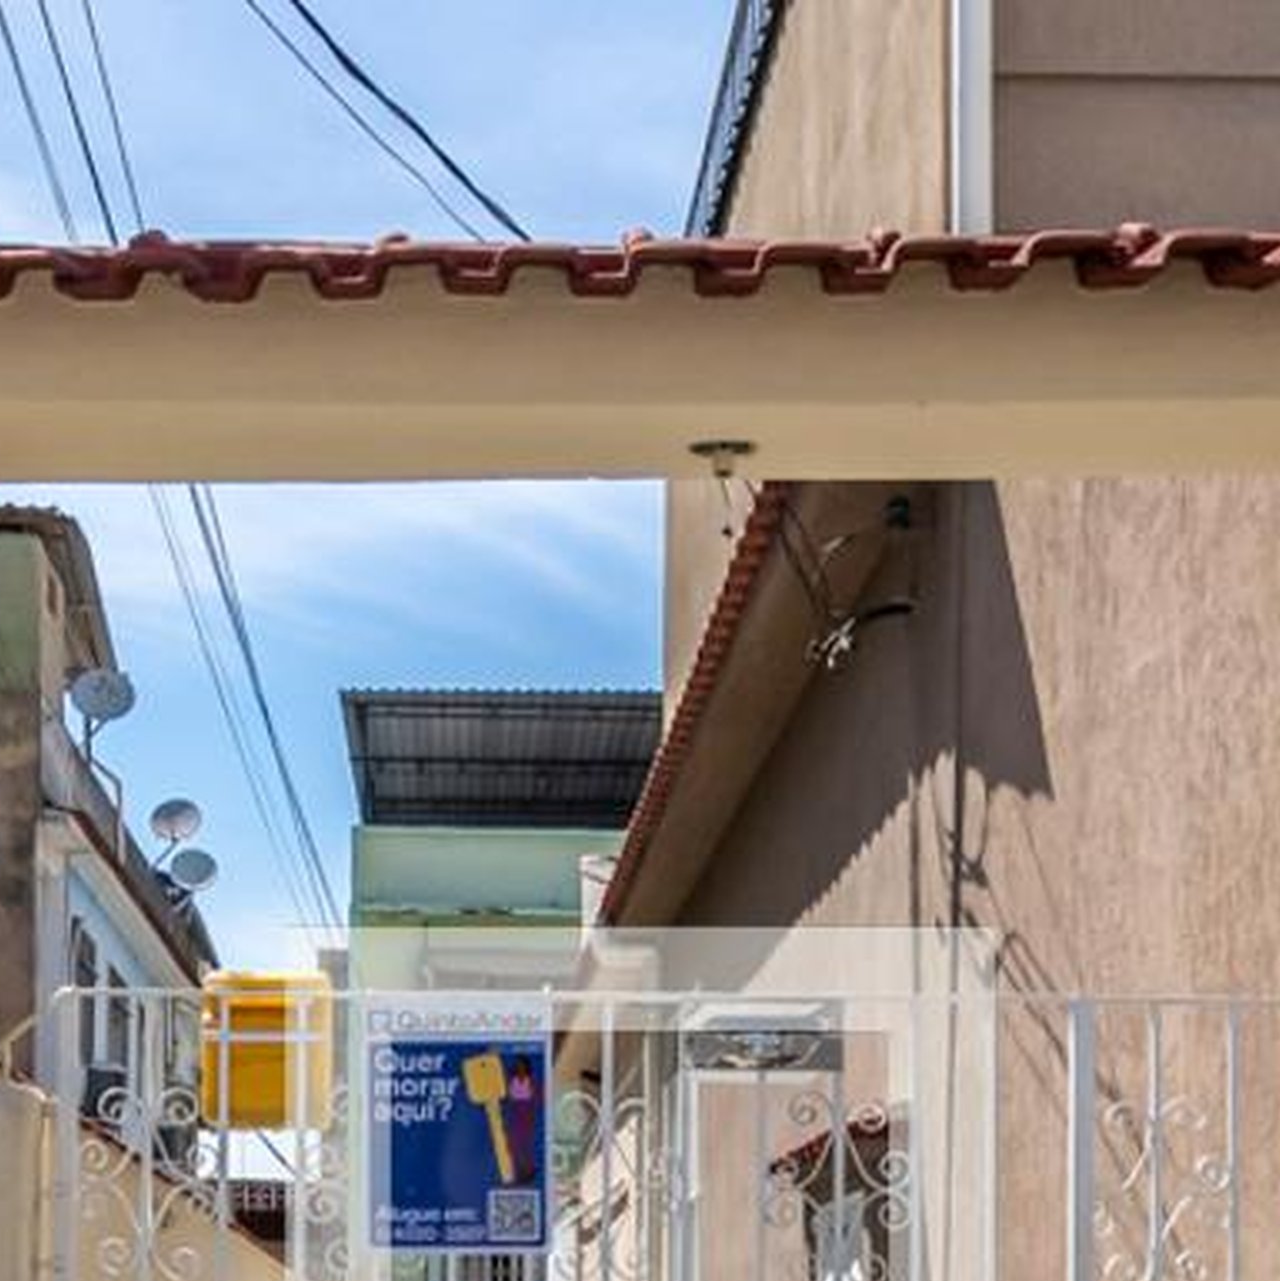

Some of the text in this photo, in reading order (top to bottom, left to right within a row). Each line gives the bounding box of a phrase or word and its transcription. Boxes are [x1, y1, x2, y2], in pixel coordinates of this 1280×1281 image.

[374, 1048, 446, 1073] Quer
[374, 1077, 458, 1097] morar
[374, 1098, 453, 1126] aqui?
